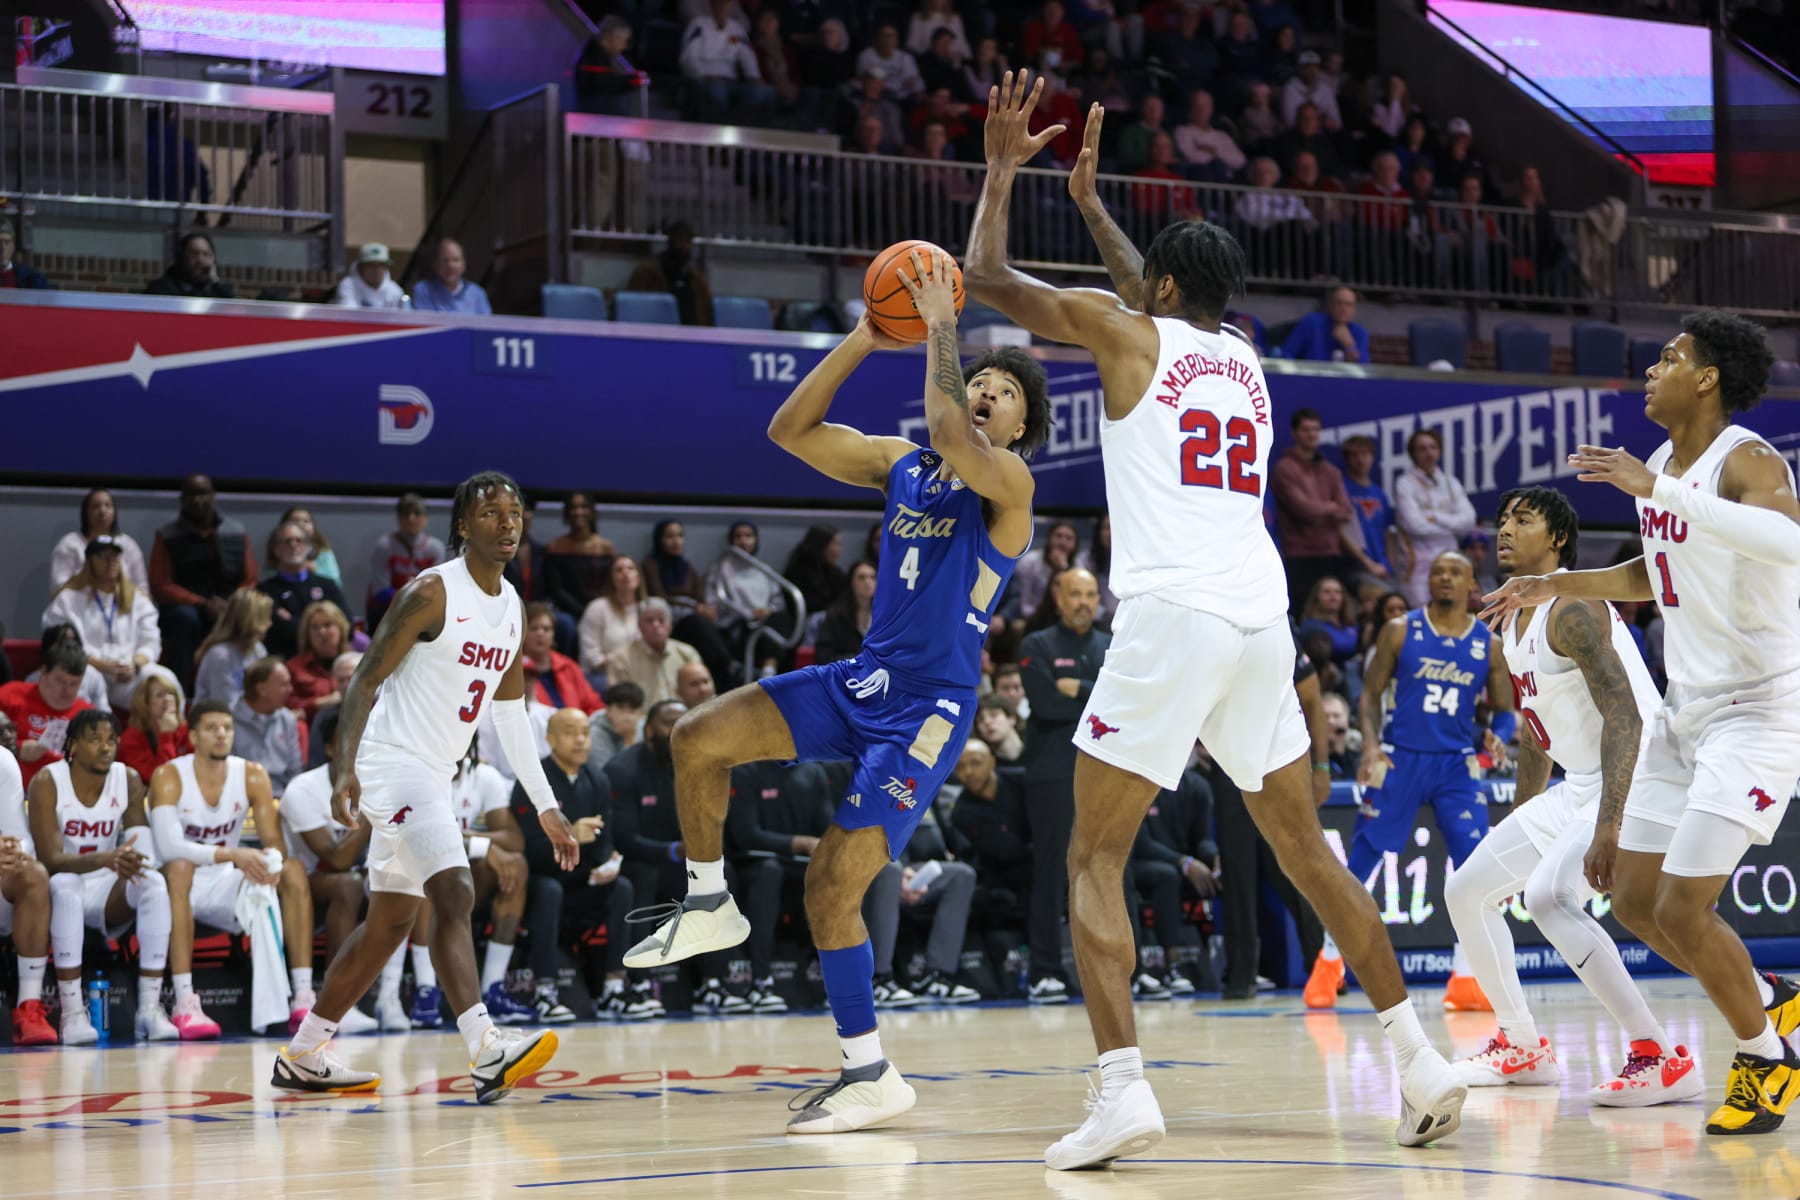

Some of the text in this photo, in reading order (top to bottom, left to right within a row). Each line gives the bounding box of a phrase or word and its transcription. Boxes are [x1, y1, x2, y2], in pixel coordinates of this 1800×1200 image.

[366, 83, 433, 118] 212
[492, 336, 535, 368] 111
[749, 351, 798, 382] 112
[921, 453, 935, 467] 32
[1179, 408, 1262, 498] 22
[888, 503, 957, 540] Tulsa
[1641, 506, 1688, 544] SMU
[899, 546, 920, 591] 4
[1655, 551, 1680, 607] 1
[458, 641, 510, 672] SMU
[1414, 657, 1475, 686] Tulsa
[459, 679, 486, 723] 3
[1423, 683, 1459, 717] 24
[1512, 671, 1537, 697] MU
[880, 776, 918, 810] Tulsa
[64, 820, 115, 838] SMU
[185, 819, 237, 840] SMU
